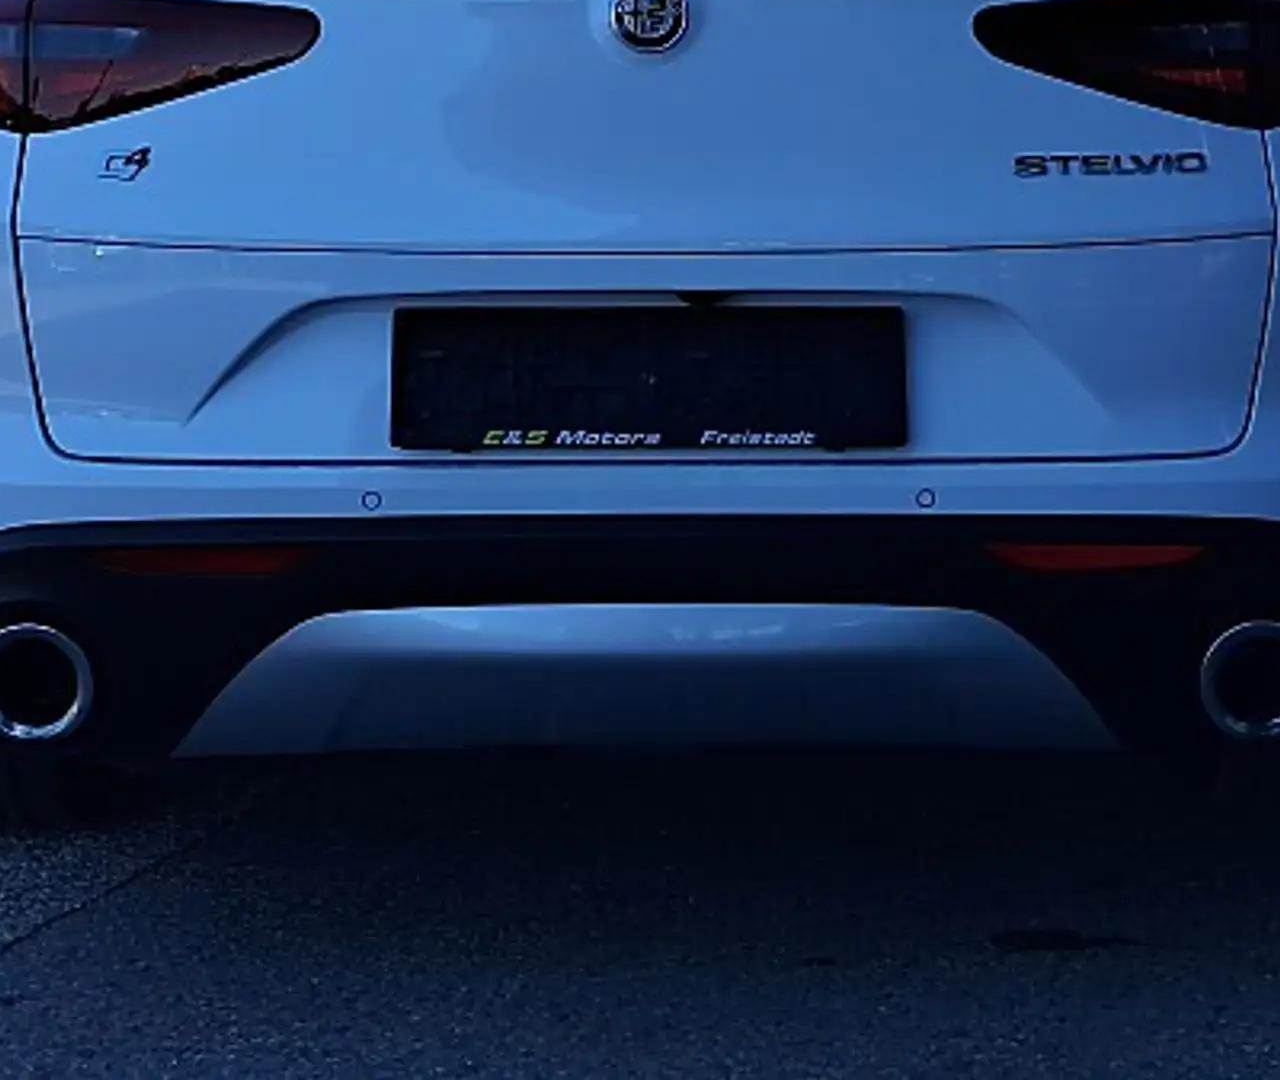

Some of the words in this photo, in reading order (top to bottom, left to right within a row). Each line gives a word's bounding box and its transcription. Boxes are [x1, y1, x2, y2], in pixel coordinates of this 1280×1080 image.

[1013, 151, 1208, 178] STELVIO
[555, 429, 661, 445] Motors
[700, 428, 815, 445] Freistadt
